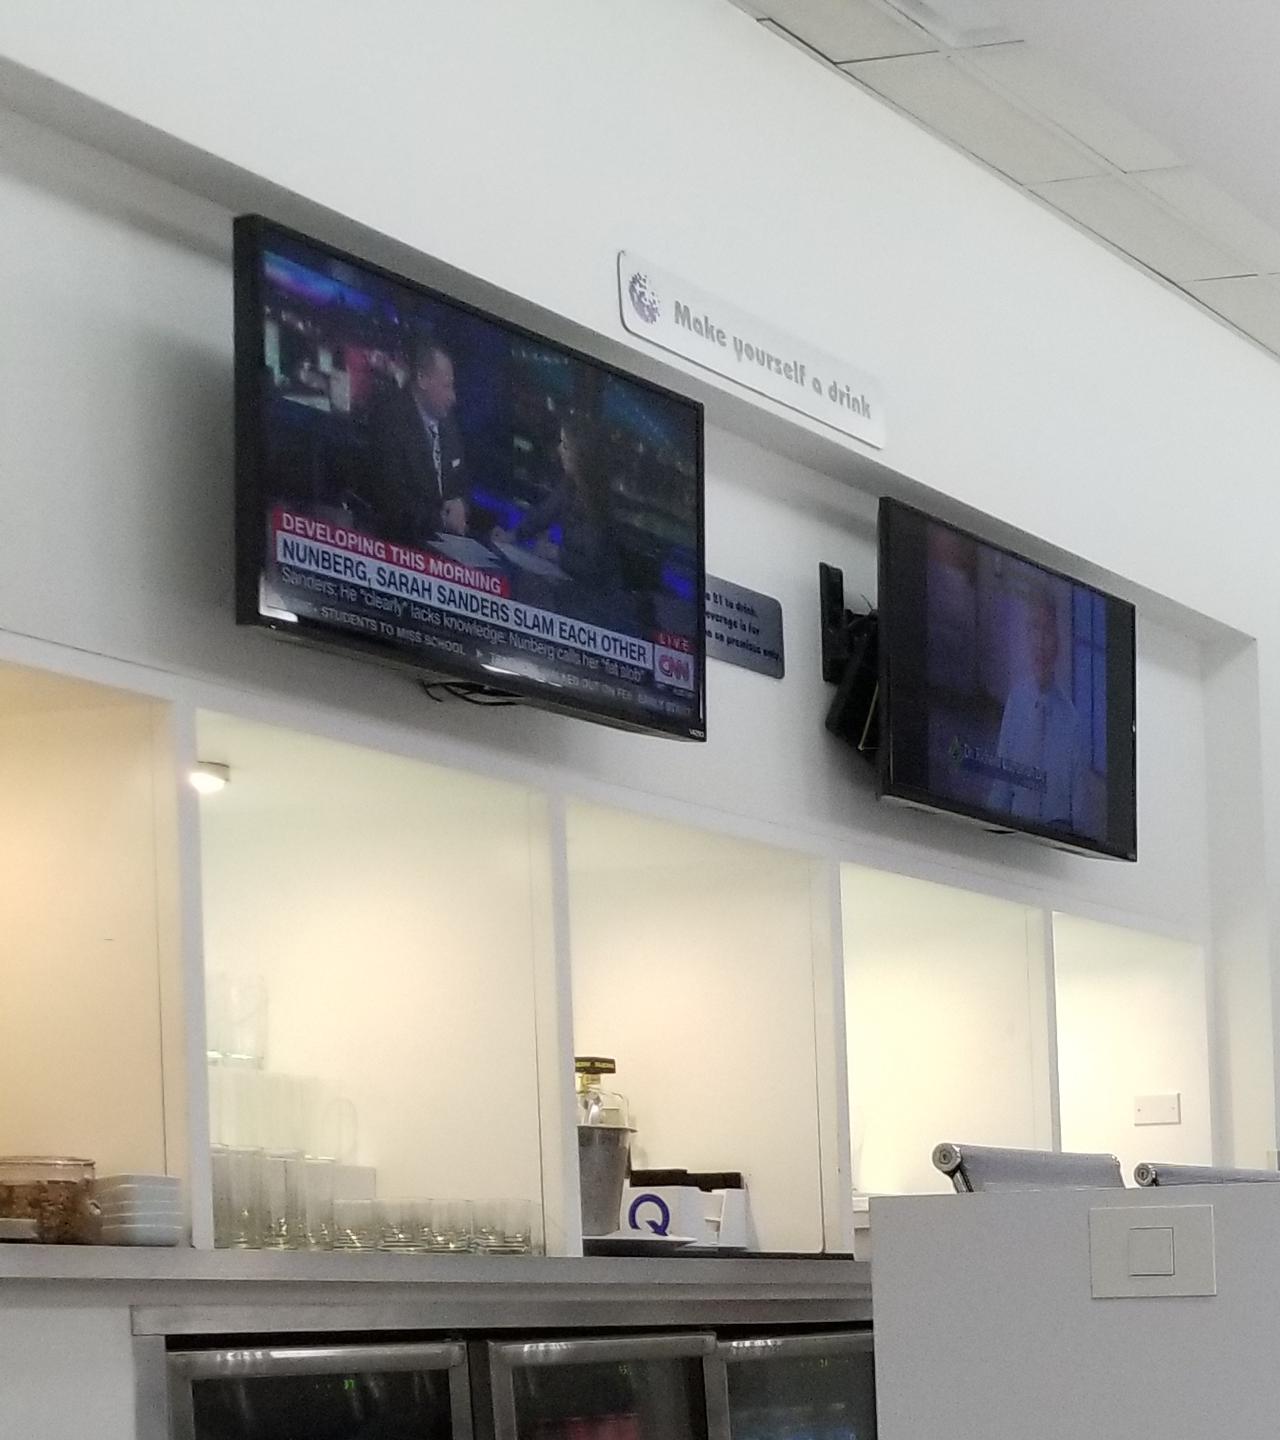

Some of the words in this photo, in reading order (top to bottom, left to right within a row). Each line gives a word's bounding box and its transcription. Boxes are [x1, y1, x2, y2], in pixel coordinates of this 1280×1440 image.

[673, 300, 727, 347] Make
[732, 336, 806, 387] yourself
[811, 376, 822, 396] a
[827, 380, 872, 419] drink
[282, 512, 386, 559] DEVELOPING
[390, 546, 425, 571] THIS
[429, 558, 501, 593] MORNING
[282, 538, 372, 587] NUNBERG,
[376, 567, 432, 601] SARAH
[436, 584, 510, 623] SANDERS
[514, 607, 554, 635] SLAM
[558, 621, 597, 648] EACH
[601, 634, 647, 664] OTHER
[319, 606, 378, 633] STUDENTS
[380, 621, 395, 637] TO
[340, 585, 358, 602] He
[410, 602, 442, 624] lacks
[509, 632, 555, 661] Nunberg
[657, 655, 690, 682] CNN
